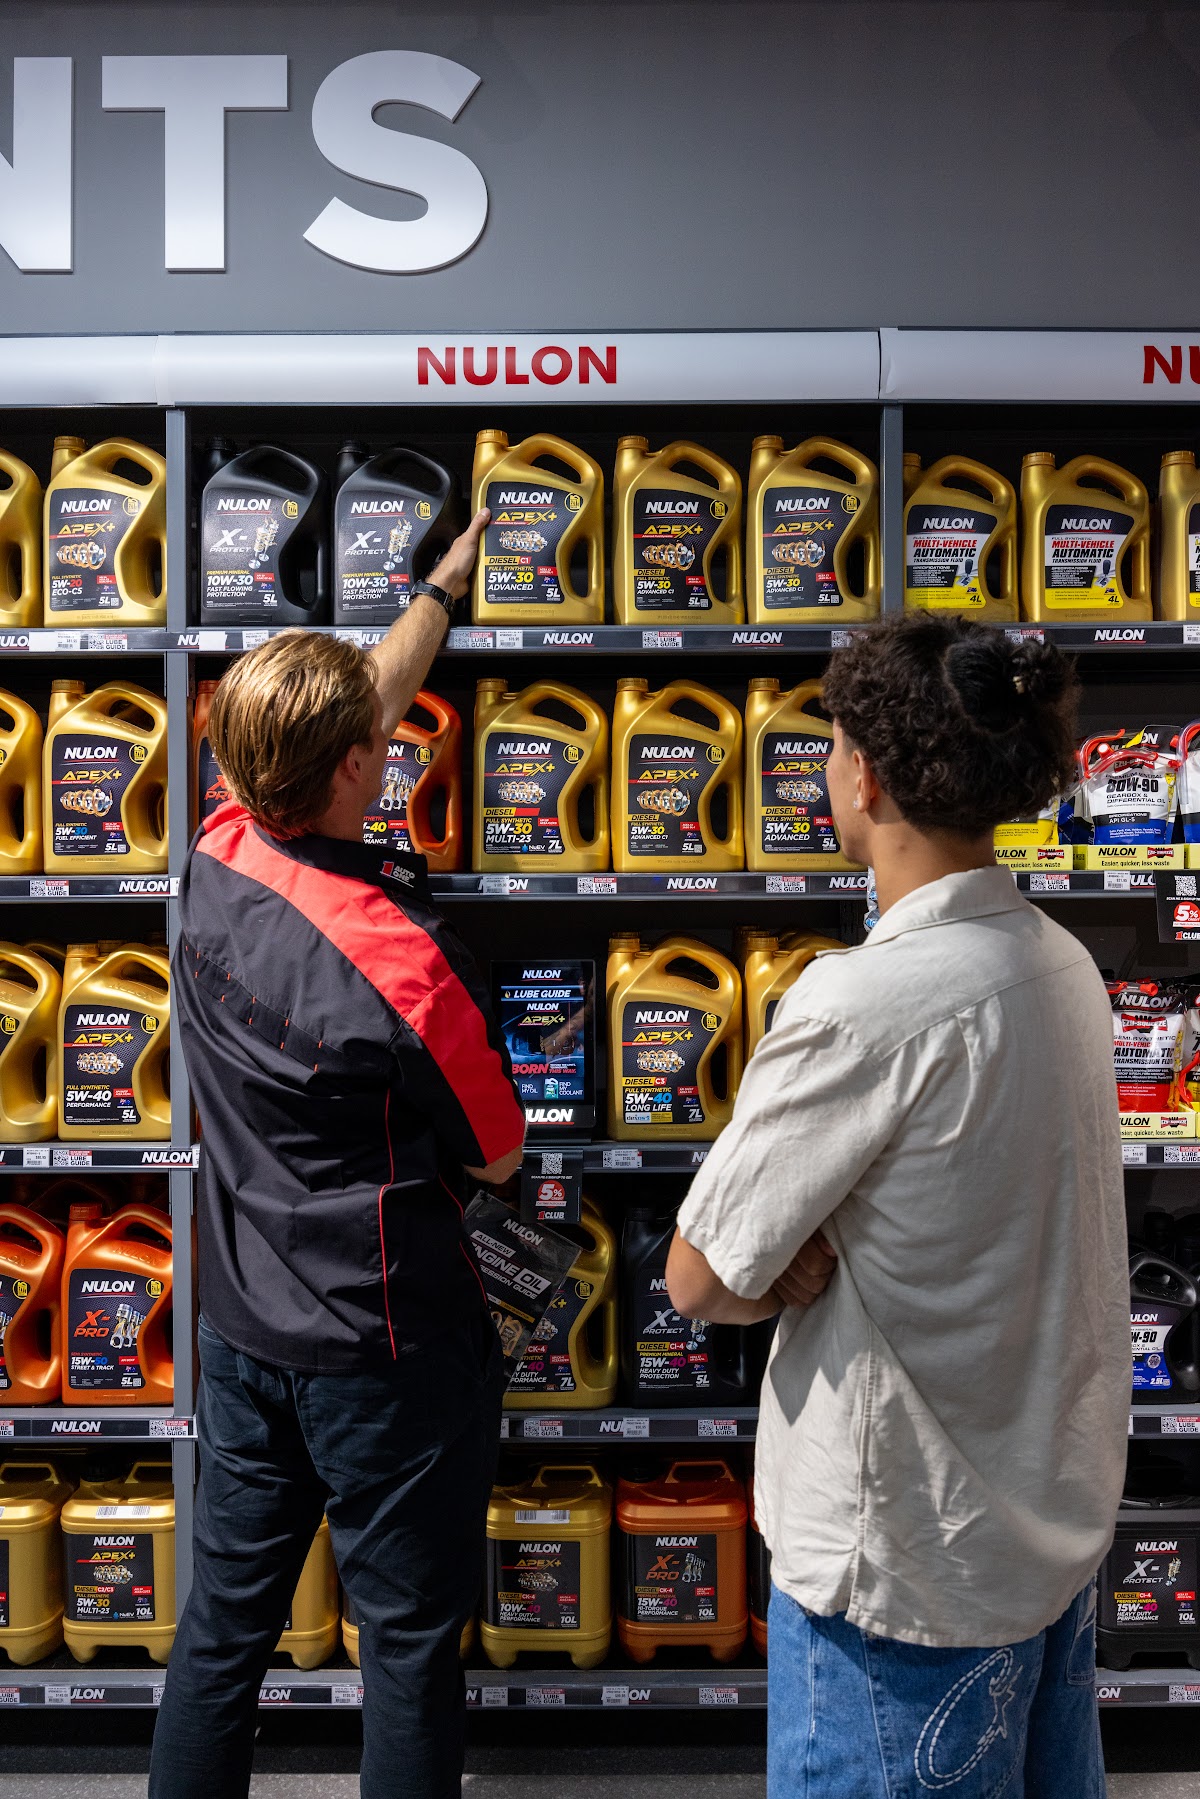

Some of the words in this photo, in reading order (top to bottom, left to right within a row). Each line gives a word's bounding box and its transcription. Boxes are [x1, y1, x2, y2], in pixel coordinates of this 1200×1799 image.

[417, 346, 617, 385] NULON
[498, 492, 553, 504] NULON
[60, 499, 111, 513] NULON
[217, 499, 271, 510] NULON
[351, 501, 404, 513] NULON
[645, 502, 699, 514] NULON
[775, 497, 829, 511] NULON
[497, 510, 557, 525] APEX+
[58, 520, 115, 535] APEX+
[773, 519, 834, 535] APEX+
[923, 518, 974, 529] NULON
[1061, 519, 1112, 530] NULON
[643, 523, 703, 538] APEX+
[913, 548, 976, 558] AUTOMATIC
[1052, 549, 1114, 557] AUTOMATIC
[207, 575, 253, 585] 10W-30
[343, 577, 388, 588] 10W-30
[488, 572, 533, 583] 5W-30
[52, 579, 82, 588] 5W-20
[487, 583, 534, 591] ADVANCED
[637, 581, 671, 589] 5W-30
[766, 579, 801, 588] 5W-30
[543, 633, 594, 644] NULON
[732, 632, 783, 644] NULON
[1094, 629, 1145, 641] NULON
[64, 747, 117, 759] NULON
[497, 743, 551, 754] NULON
[641, 747, 695, 758] NULON
[774, 742, 828, 754] NULON
[495, 761, 555, 776] APEX+
[61, 768, 122, 784] APEX+
[639, 768, 699, 783] APEX+
[1106, 779, 1159, 792] 80W-90
[56, 827, 88, 835] 5W-30
[486, 824, 532, 834] 5W-30
[631, 826, 665, 834] 5W-30
[765, 822, 810, 833] 5W-30
[486, 835, 532, 843] MULTI-23
[1098, 848, 1136, 856] NULON
[393, 871, 410, 882] ONE
[394, 865, 415, 879] AUTO
[118, 881, 168, 892] NULON
[667, 878, 717, 889] NULON
[1175, 905, 1198, 921] 5%
[522, 970, 561, 978] NULON
[514, 990, 539, 998] LUBE
[541, 990, 571, 998] GUIDE
[1119, 995, 1172, 1007] NULON
[527, 1003, 559, 1011] NULON
[77, 1014, 129, 1025] NULON
[521, 1014, 565, 1025] APEX+
[635, 1011, 689, 1023] NULON
[74, 1031, 134, 1047] APEX+
[633, 1029, 693, 1045] APEX+
[512, 1064, 549, 1074] BORN
[66, 1090, 112, 1102] 5W-40
[625, 1093, 672, 1104] 5W-40
[142, 1152, 192, 1164] NULON
[540, 1184, 562, 1200] 5%
[503, 1219, 544, 1245] NULON
[476, 1234, 512, 1255] ALL-NEW
[472, 1243, 520, 1277] NGINE
[520, 1273, 543, 1291] OIL
[82, 1281, 135, 1292] NULON
[513, 1284, 538, 1299] GUIDE
[74, 1328, 109, 1337] PRO
[71, 1357, 107, 1365] 15W-50
[639, 1357, 686, 1368] 15W-40
[51, 1422, 101, 1433] NULON
[94, 1537, 134, 1546] NULON
[656, 1537, 697, 1547] NULON
[1135, 1542, 1177, 1552] NULON
[519, 1544, 561, 1553] NULON
[91, 1550, 135, 1562] APEX+
[516, 1558, 561, 1568] APEX+
[646, 1572, 679, 1580] PRO
[76, 1598, 110, 1607] 5W-30
[637, 1598, 677, 1606] 15W-40
[1117, 1603, 1158, 1612] 15W-40
[500, 1604, 540, 1613] 10W-40
